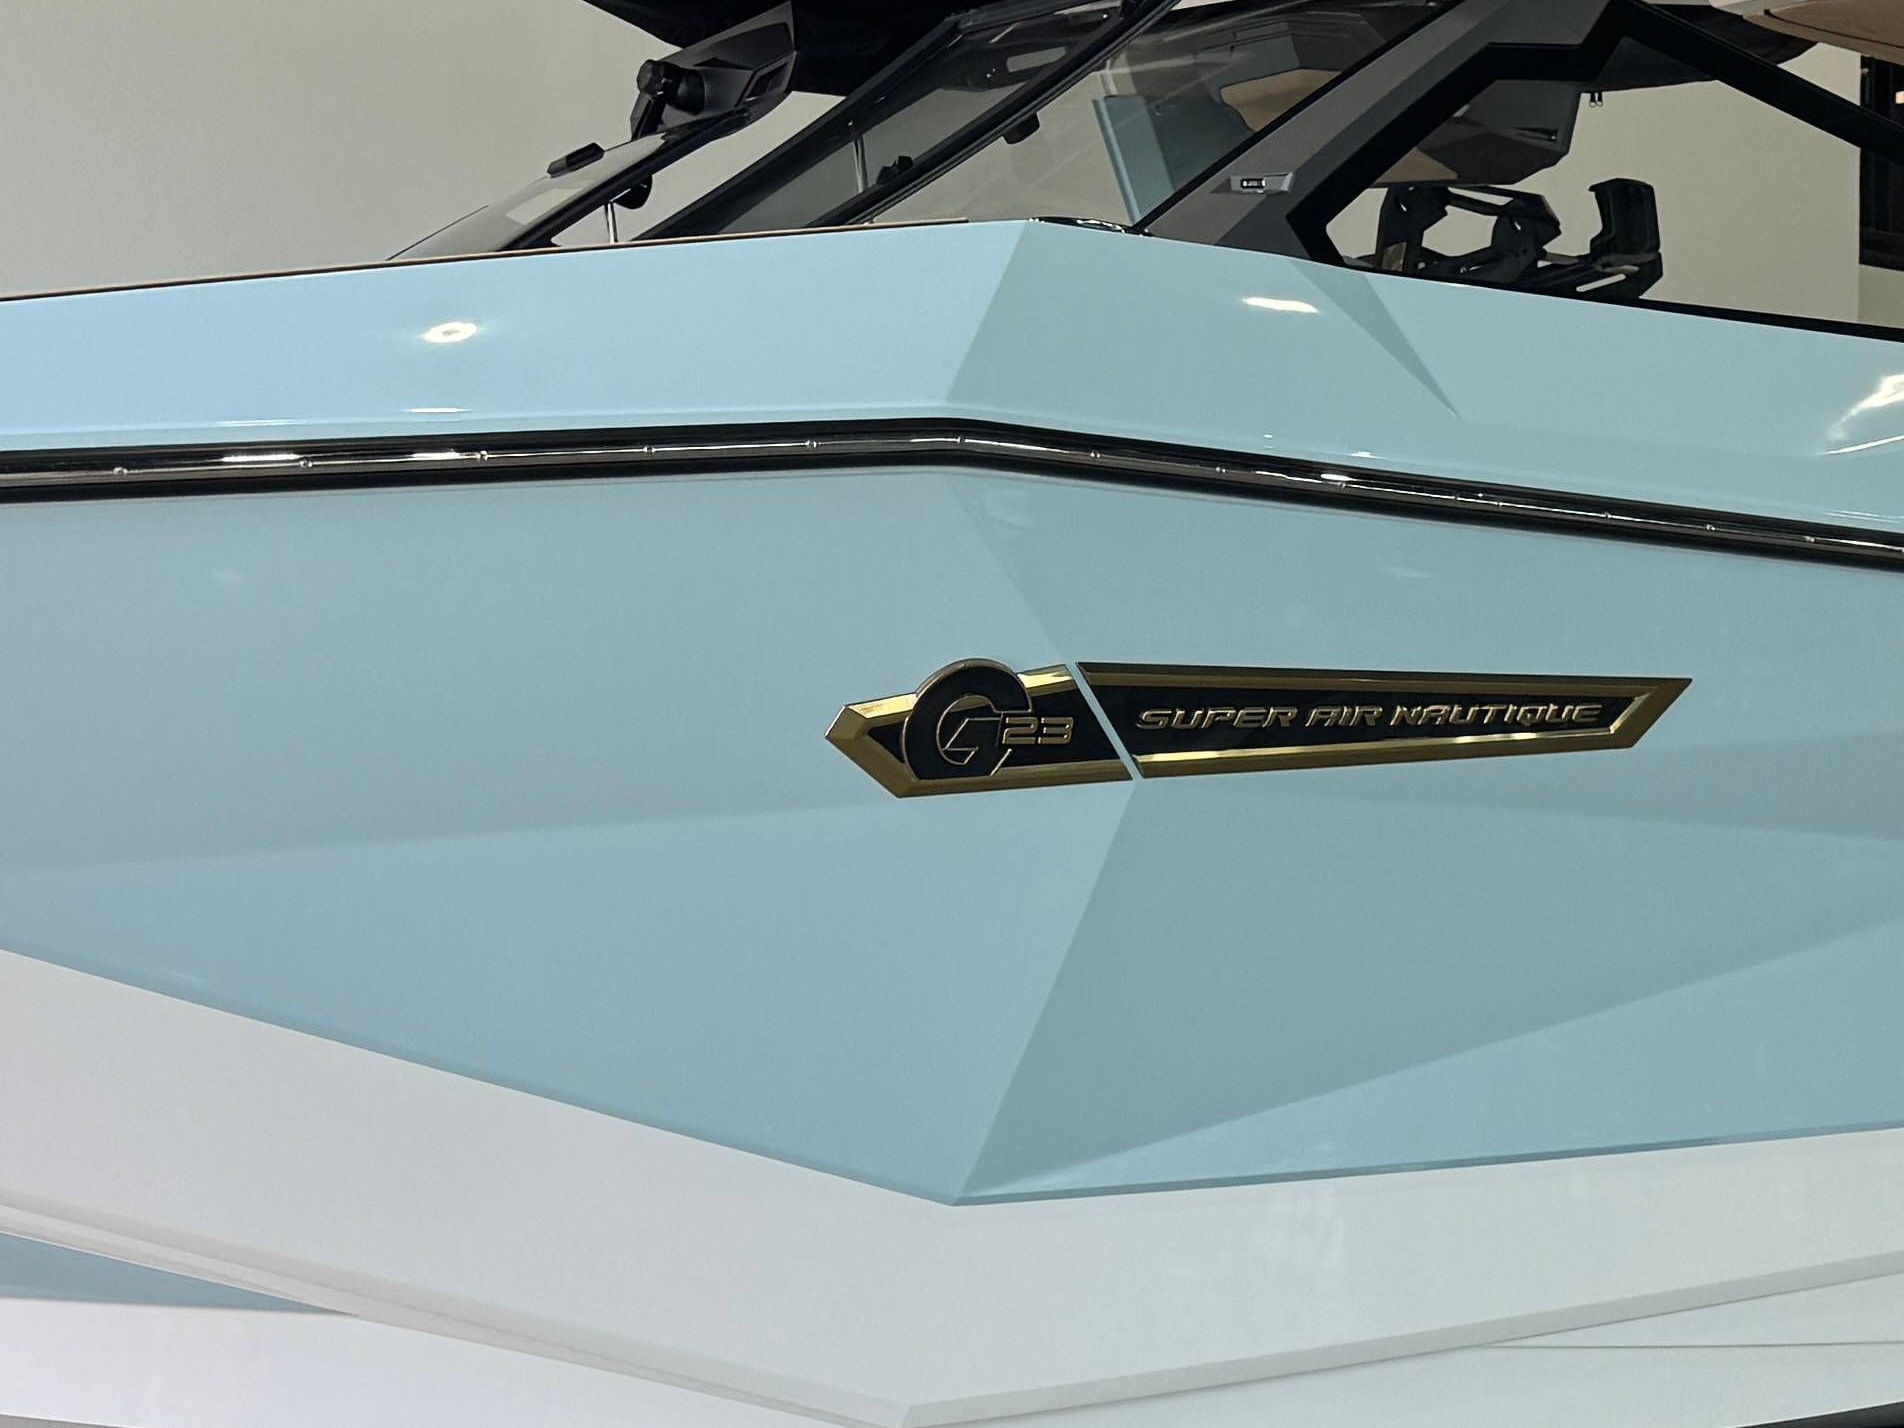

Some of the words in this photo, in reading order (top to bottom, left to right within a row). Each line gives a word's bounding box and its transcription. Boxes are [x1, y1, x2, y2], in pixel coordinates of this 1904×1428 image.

[1135, 705, 1298, 730] SUPER
[1305, 705, 1383, 728] AIR
[1389, 702, 1603, 727] NAUTIQUE
